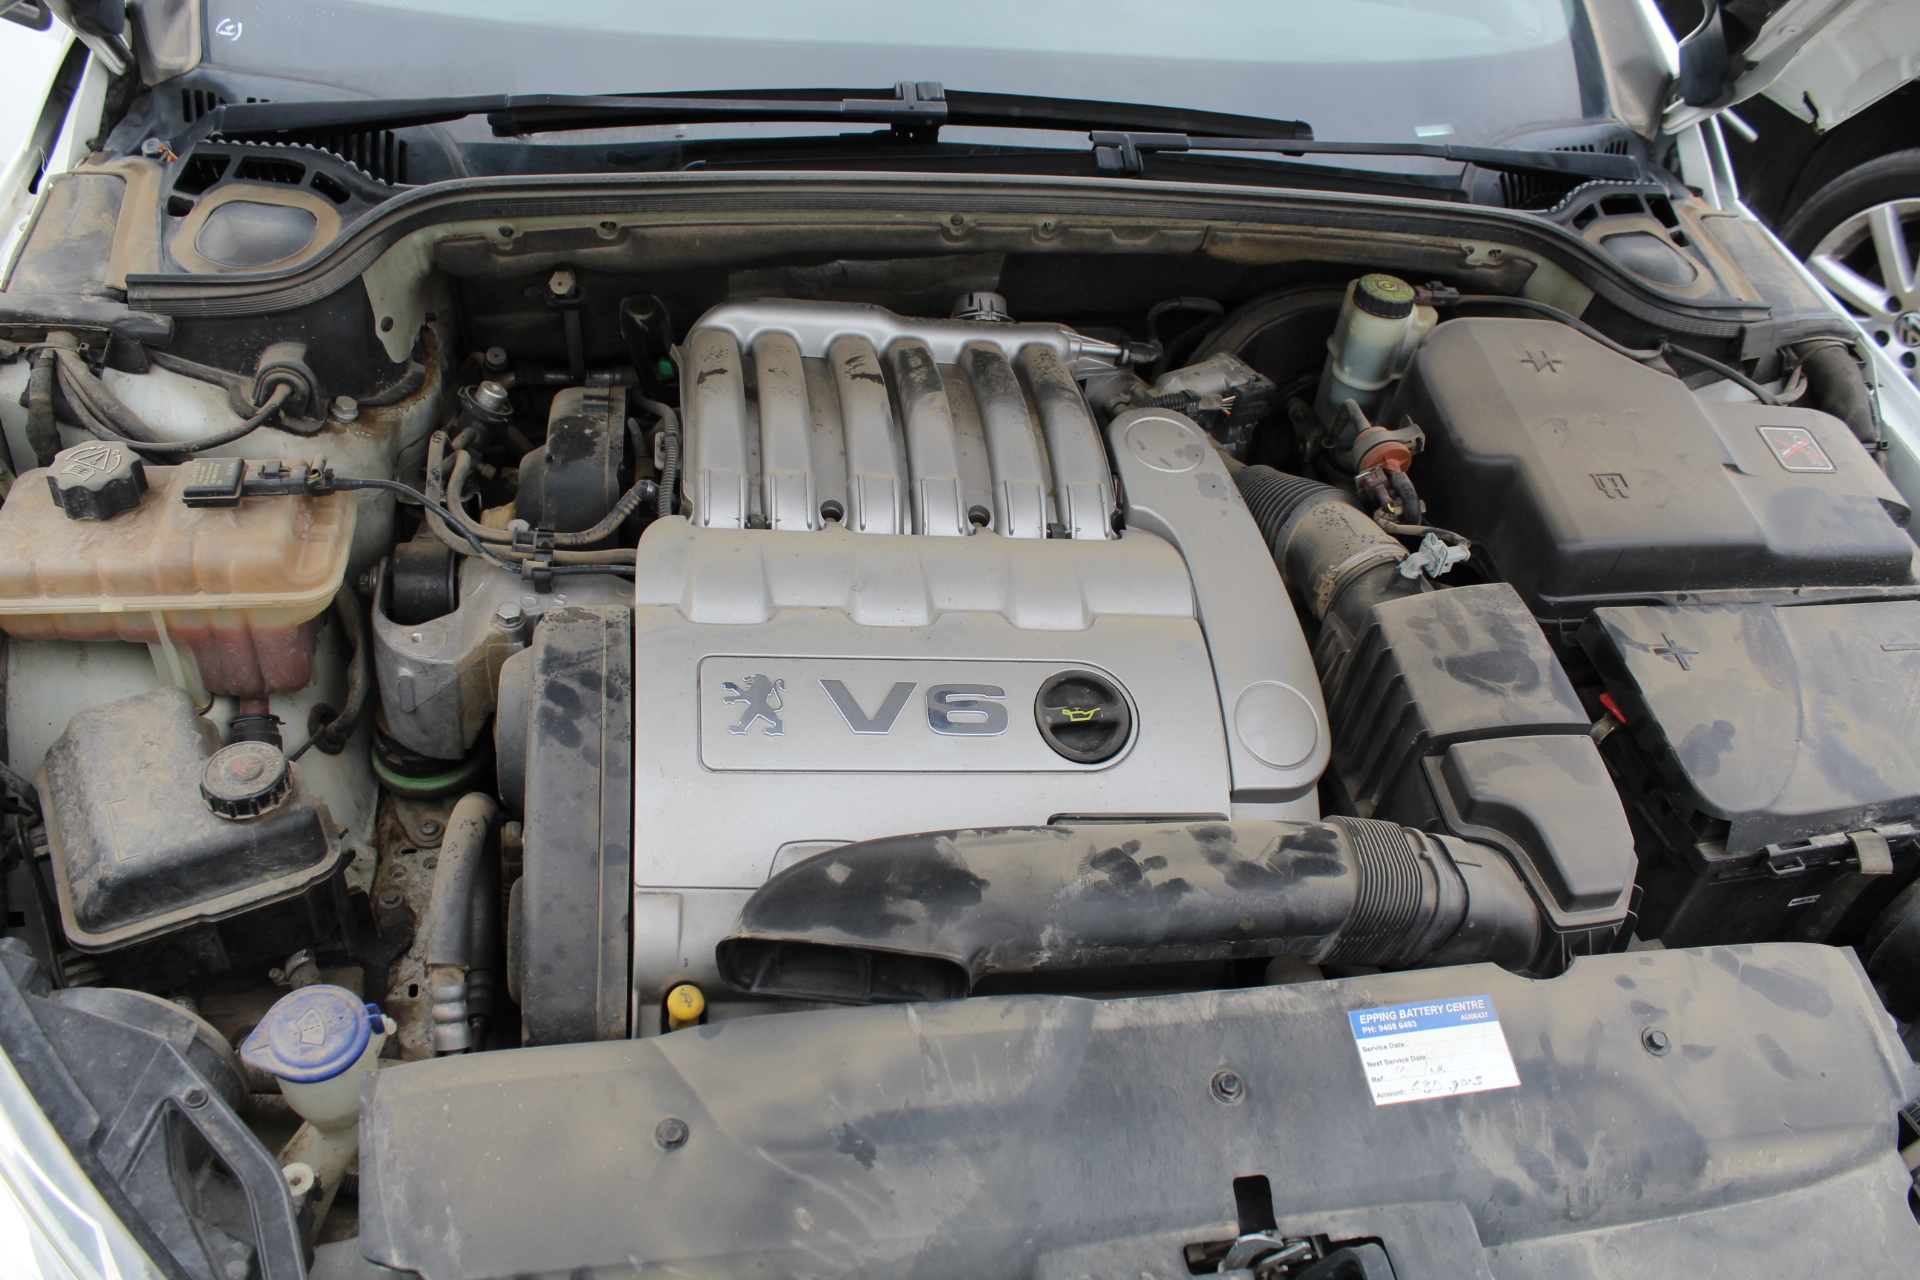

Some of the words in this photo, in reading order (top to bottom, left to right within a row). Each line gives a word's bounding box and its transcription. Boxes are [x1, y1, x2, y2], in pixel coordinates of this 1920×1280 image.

[819, 679, 1009, 736] V6
[1359, 1010, 1397, 1025] EPPING
[1399, 1004, 1444, 1020] BATTERY
[1445, 999, 1485, 1013] CENTRE
[1361, 1025, 1378, 1035] PH:
[1378, 1023, 1397, 1033] 9408
[1398, 1020, 1417, 1031] 6493
[1362, 1043, 1388, 1053] Service
[1388, 1041, 1406, 1050] Date:
[1367, 1059, 1383, 1069] Next
[1384, 1056, 1410, 1067] Service
[1410, 1053, 1429, 1063] Date:
[1371, 1075, 1386, 1084] Ref:
[1376, 1089, 1406, 1099] Amount:
